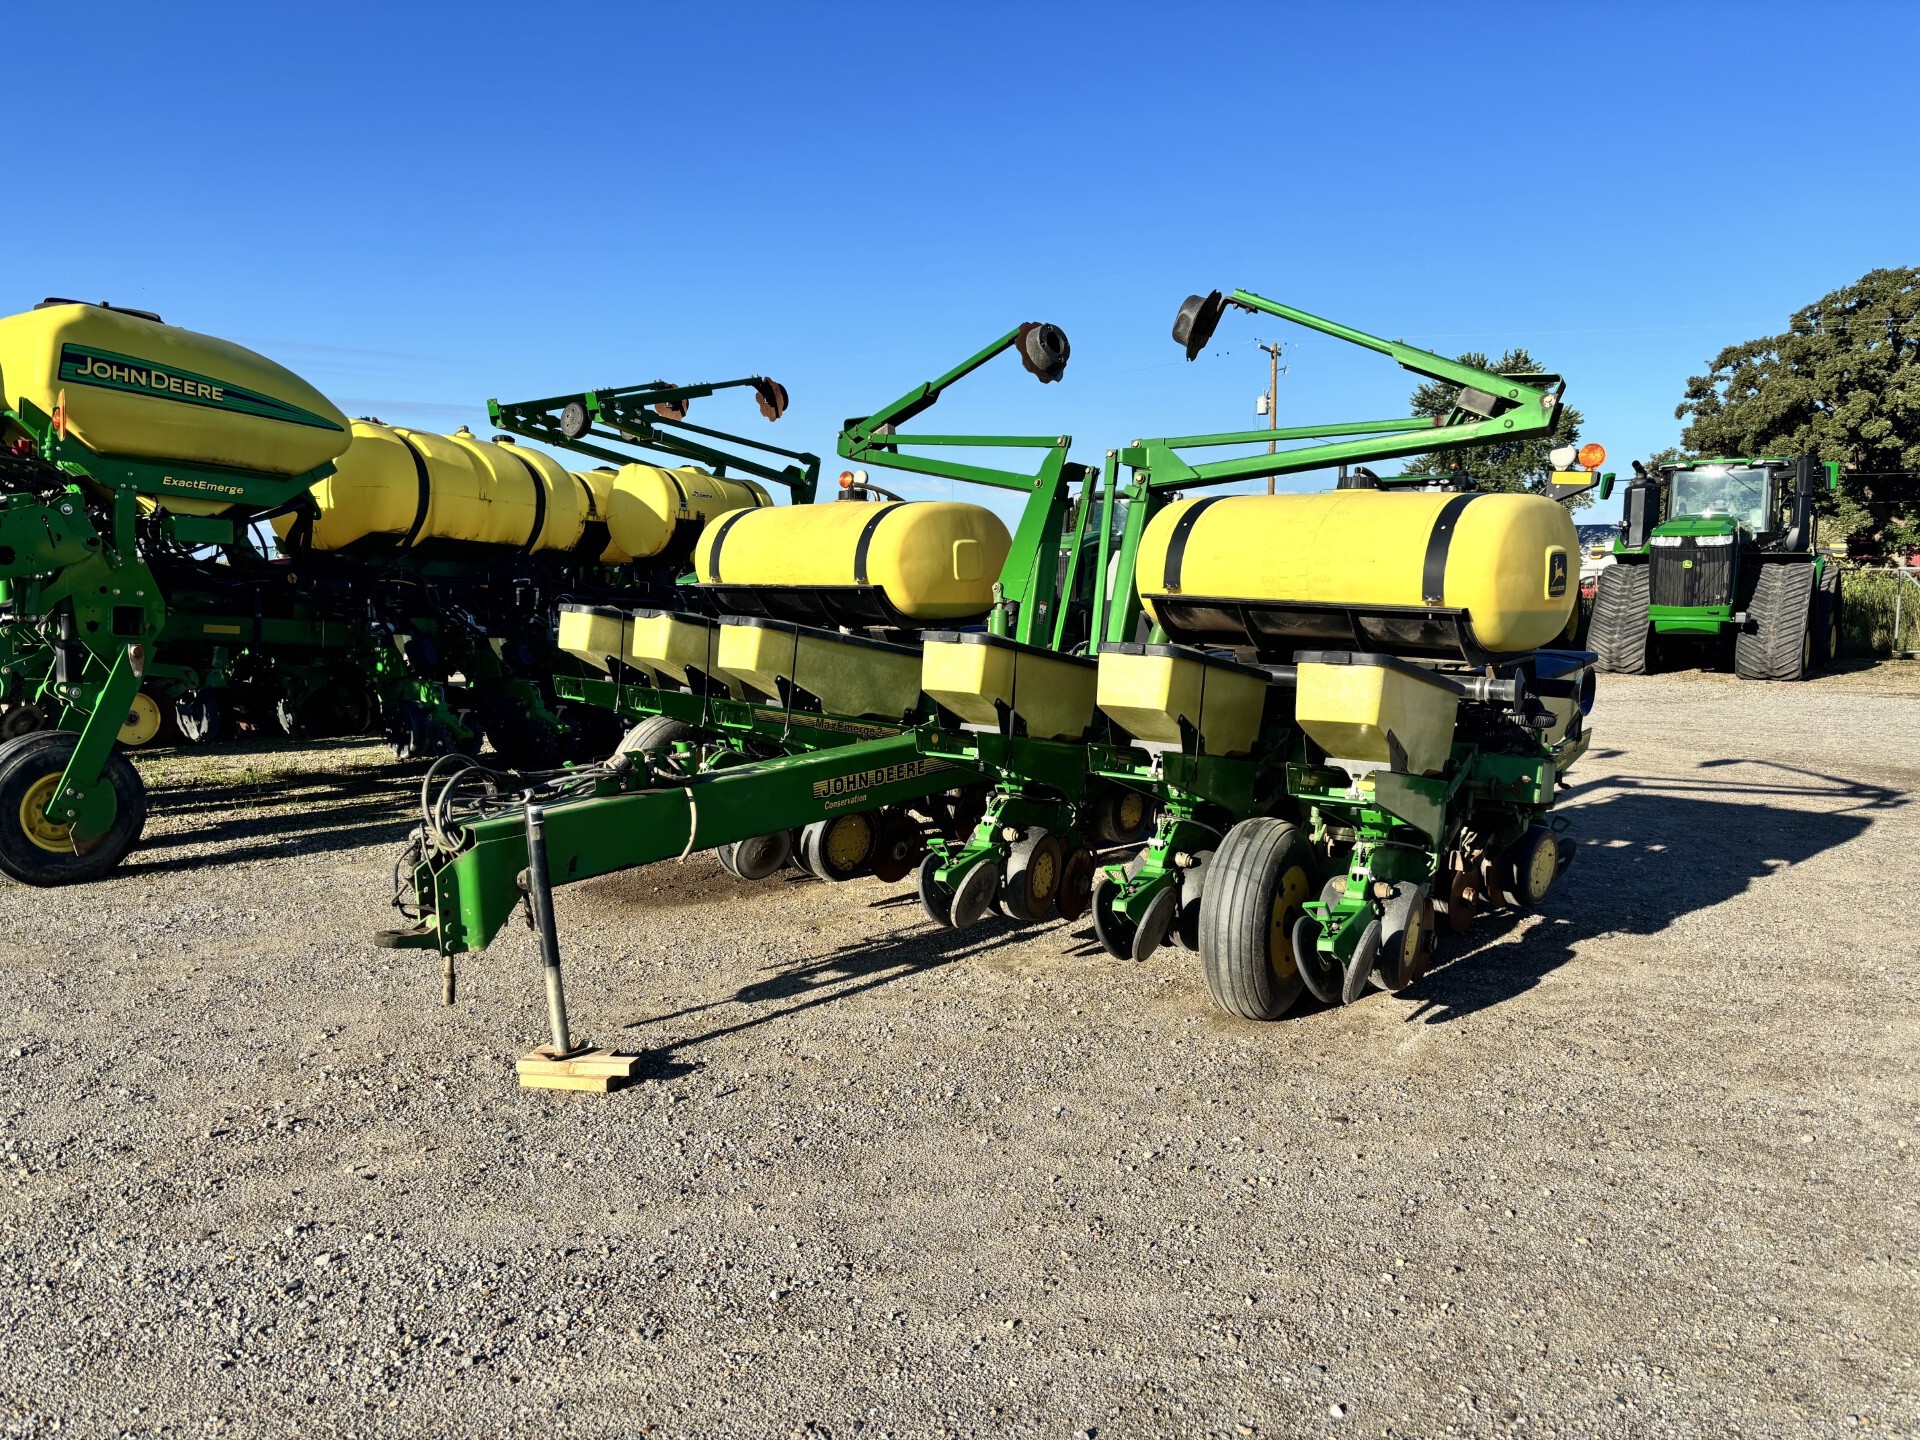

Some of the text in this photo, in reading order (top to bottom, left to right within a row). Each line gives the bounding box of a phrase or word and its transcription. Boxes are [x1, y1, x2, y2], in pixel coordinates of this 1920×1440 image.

[77, 357, 225, 402] JOHN DEERE
[162, 476, 244, 495] ExactEmerge
[814, 718, 875, 736] MaxEmerge
[820, 759, 926, 798] JOHN DEERE
[824, 794, 867, 810] Conservation
